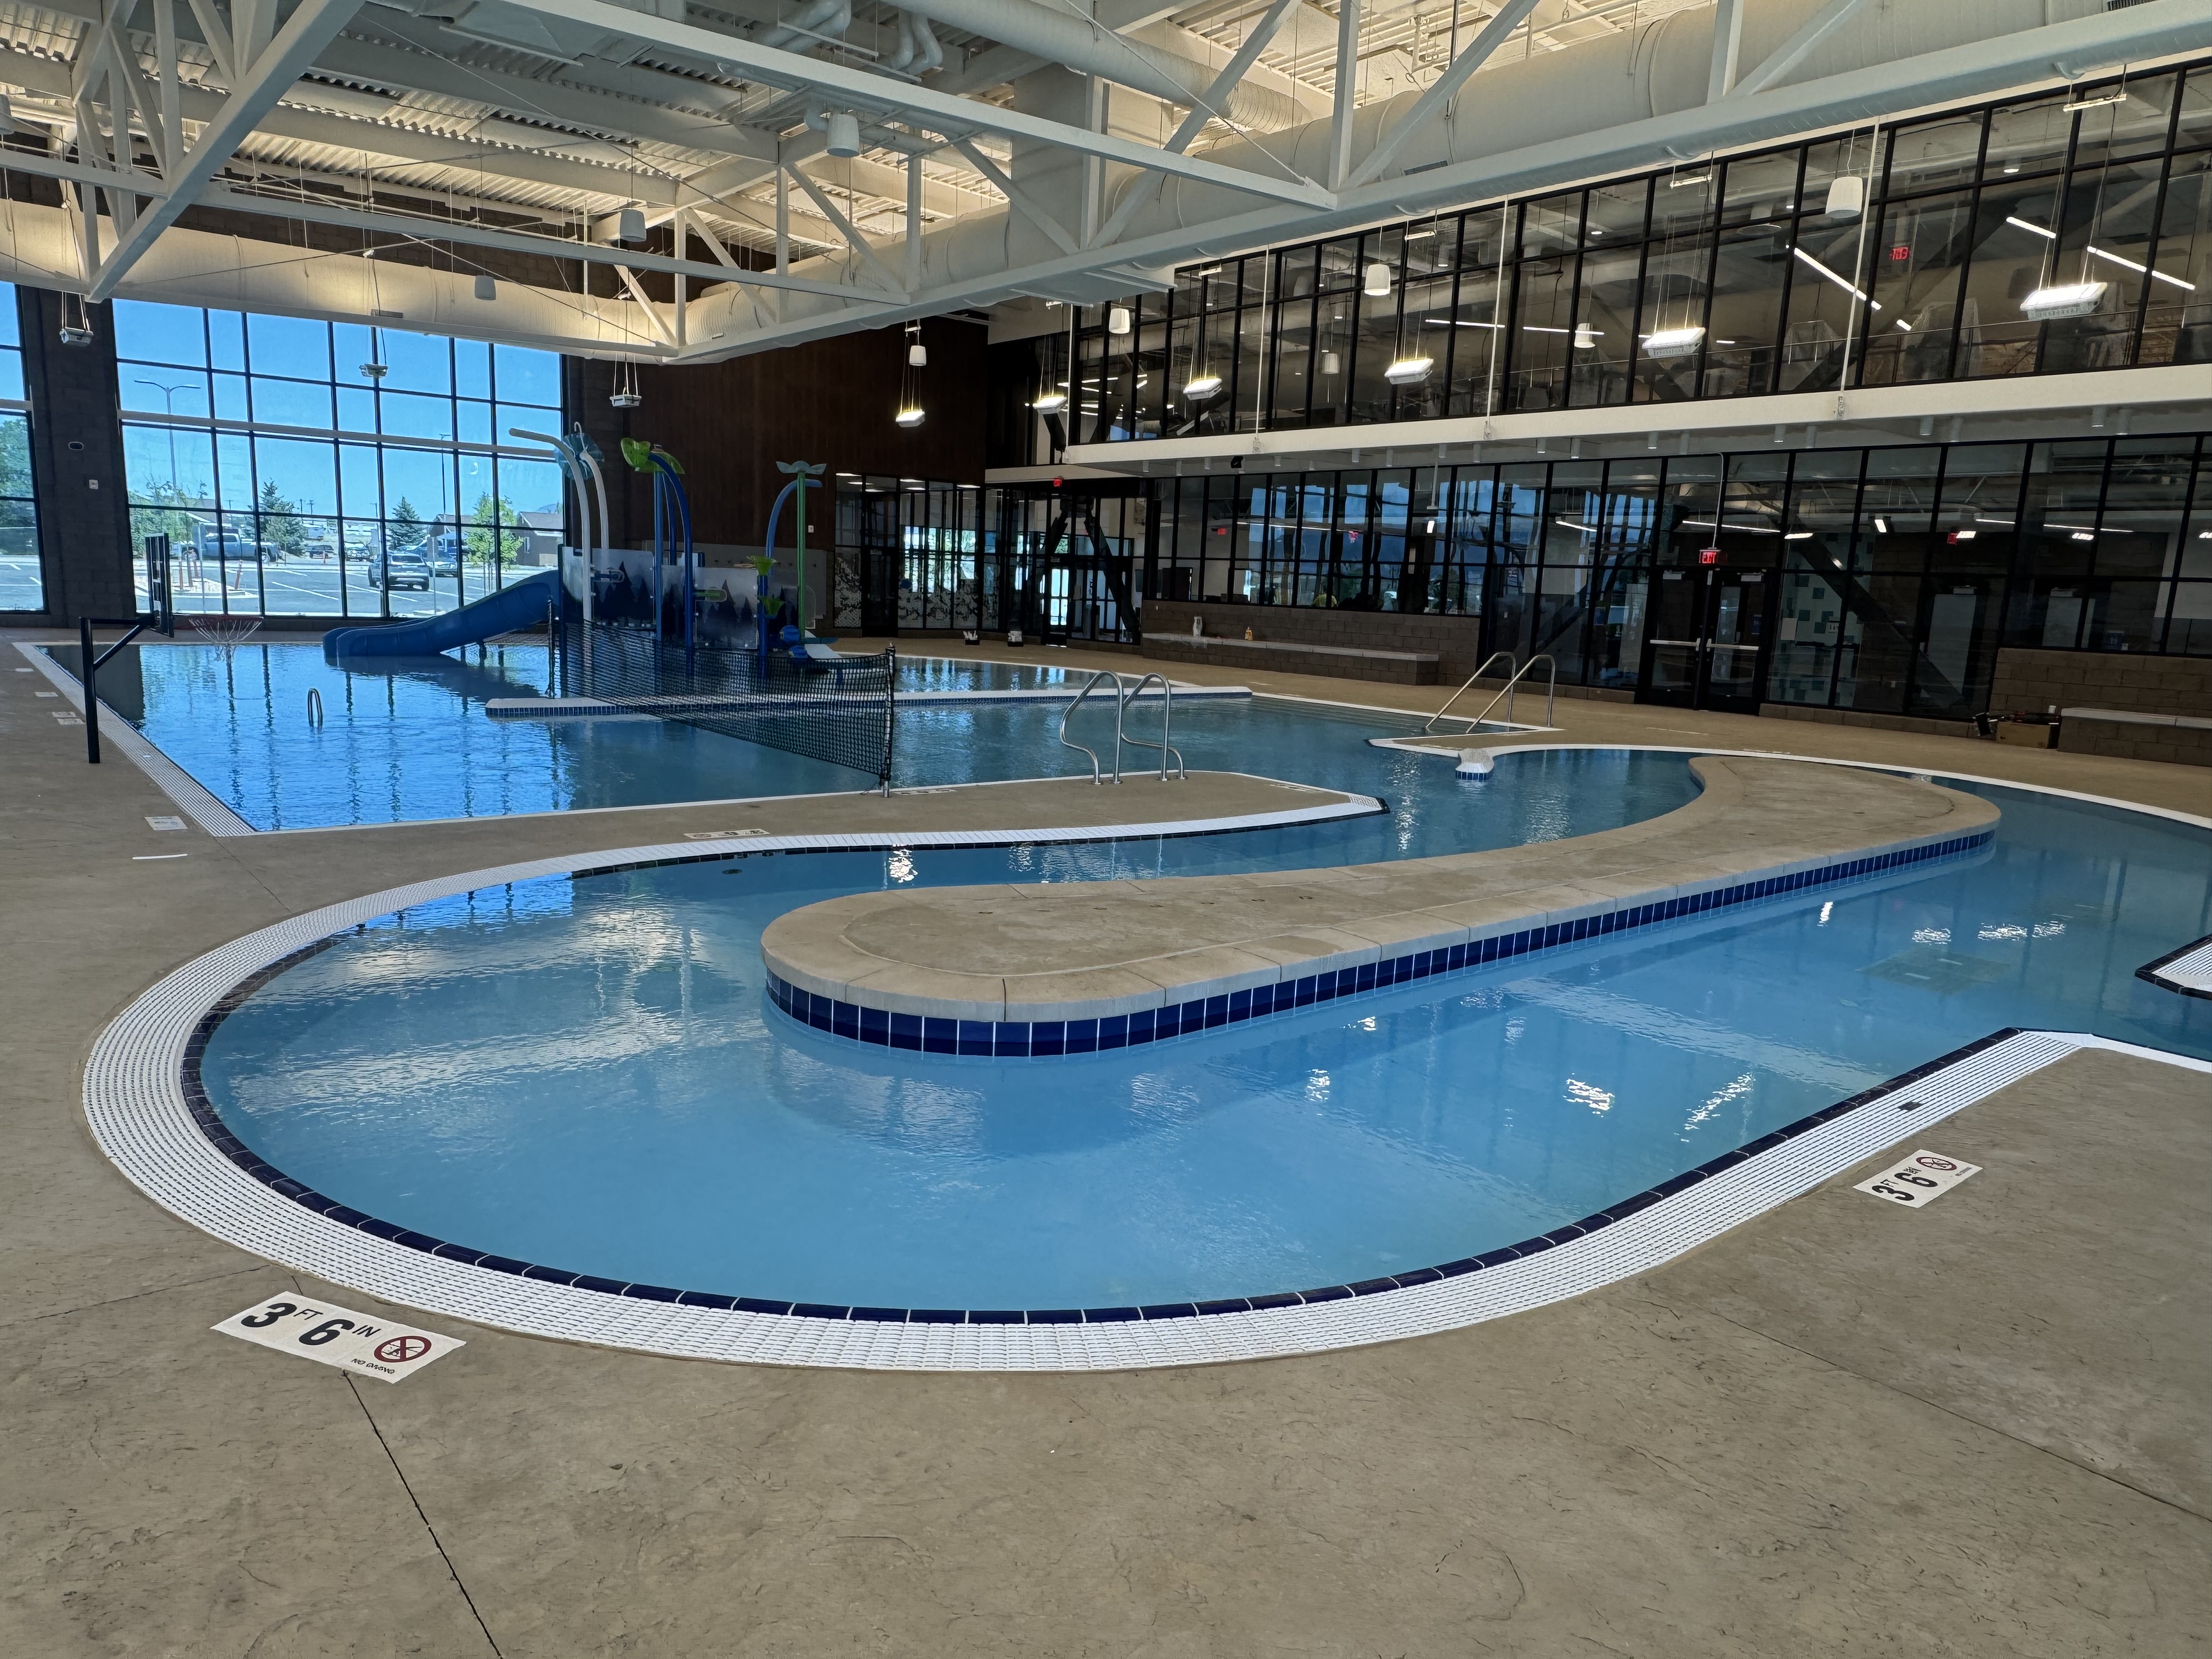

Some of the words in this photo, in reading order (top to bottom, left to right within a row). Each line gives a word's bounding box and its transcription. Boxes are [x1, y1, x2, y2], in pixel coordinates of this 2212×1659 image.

[1872, 1185, 1915, 1201] 3
[1894, 1172, 1938, 1187] 6
[240, 1302, 297, 1328] 3
[294, 1308, 324, 1320] FT
[298, 1319, 355, 1346] 6
[352, 1324, 381, 1338] IN
